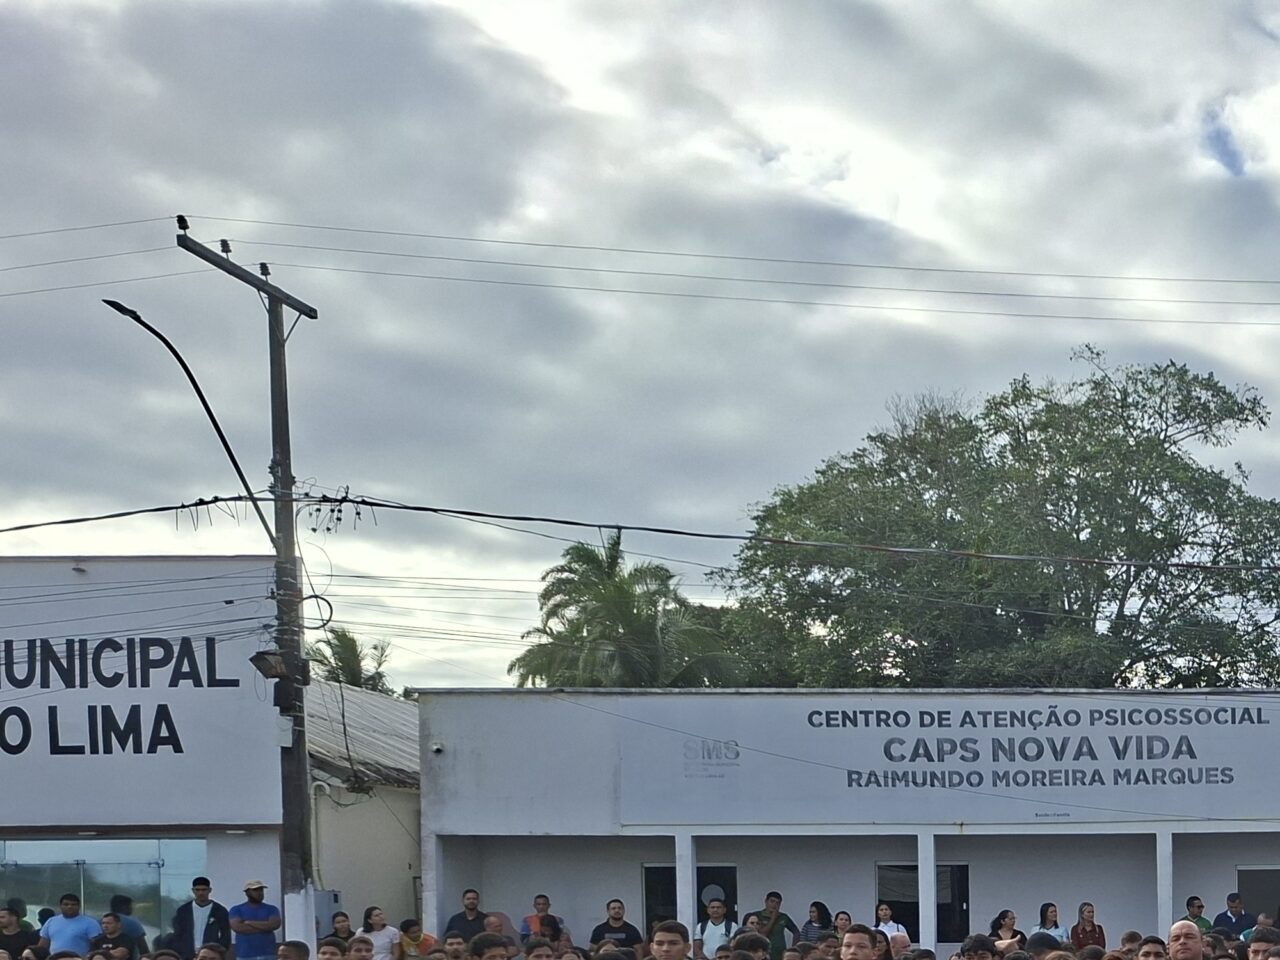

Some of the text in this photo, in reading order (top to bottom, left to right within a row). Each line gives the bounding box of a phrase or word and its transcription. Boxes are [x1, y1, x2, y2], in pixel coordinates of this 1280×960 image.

[0, 637, 240, 689] UNICIPAL
[0, 704, 184, 756] O LIMA
[807, 705, 1270, 730] CENTRO DE ATENÇÃO PSICOSSOCIAL
[683, 740, 740, 760] SMS
[883, 735, 1198, 763] CAPS NOVA VIDA
[847, 767, 1235, 788] RAIMUNDO MOREIRA MARQUES
